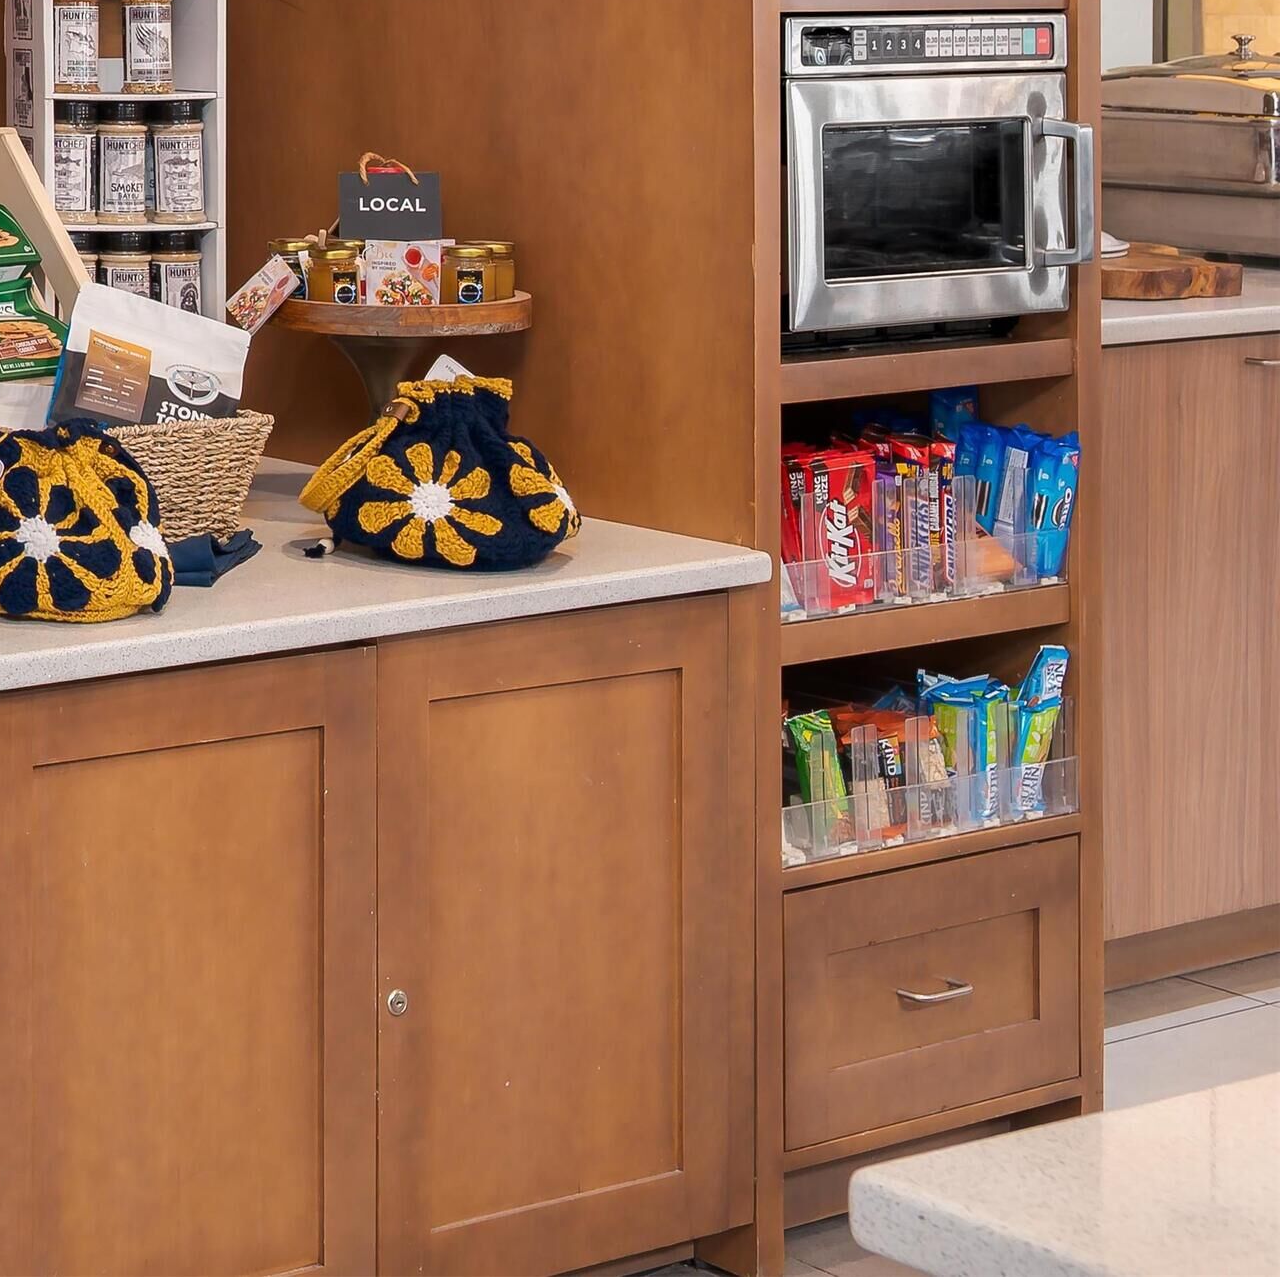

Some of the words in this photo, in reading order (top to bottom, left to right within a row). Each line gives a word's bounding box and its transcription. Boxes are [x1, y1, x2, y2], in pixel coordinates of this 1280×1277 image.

[160, 140, 199, 150] HUNTCHEF
[111, 182, 143, 193] SMOKEY
[358, 197, 426, 212] LOCAL
[879, 739, 897, 776] KIND
